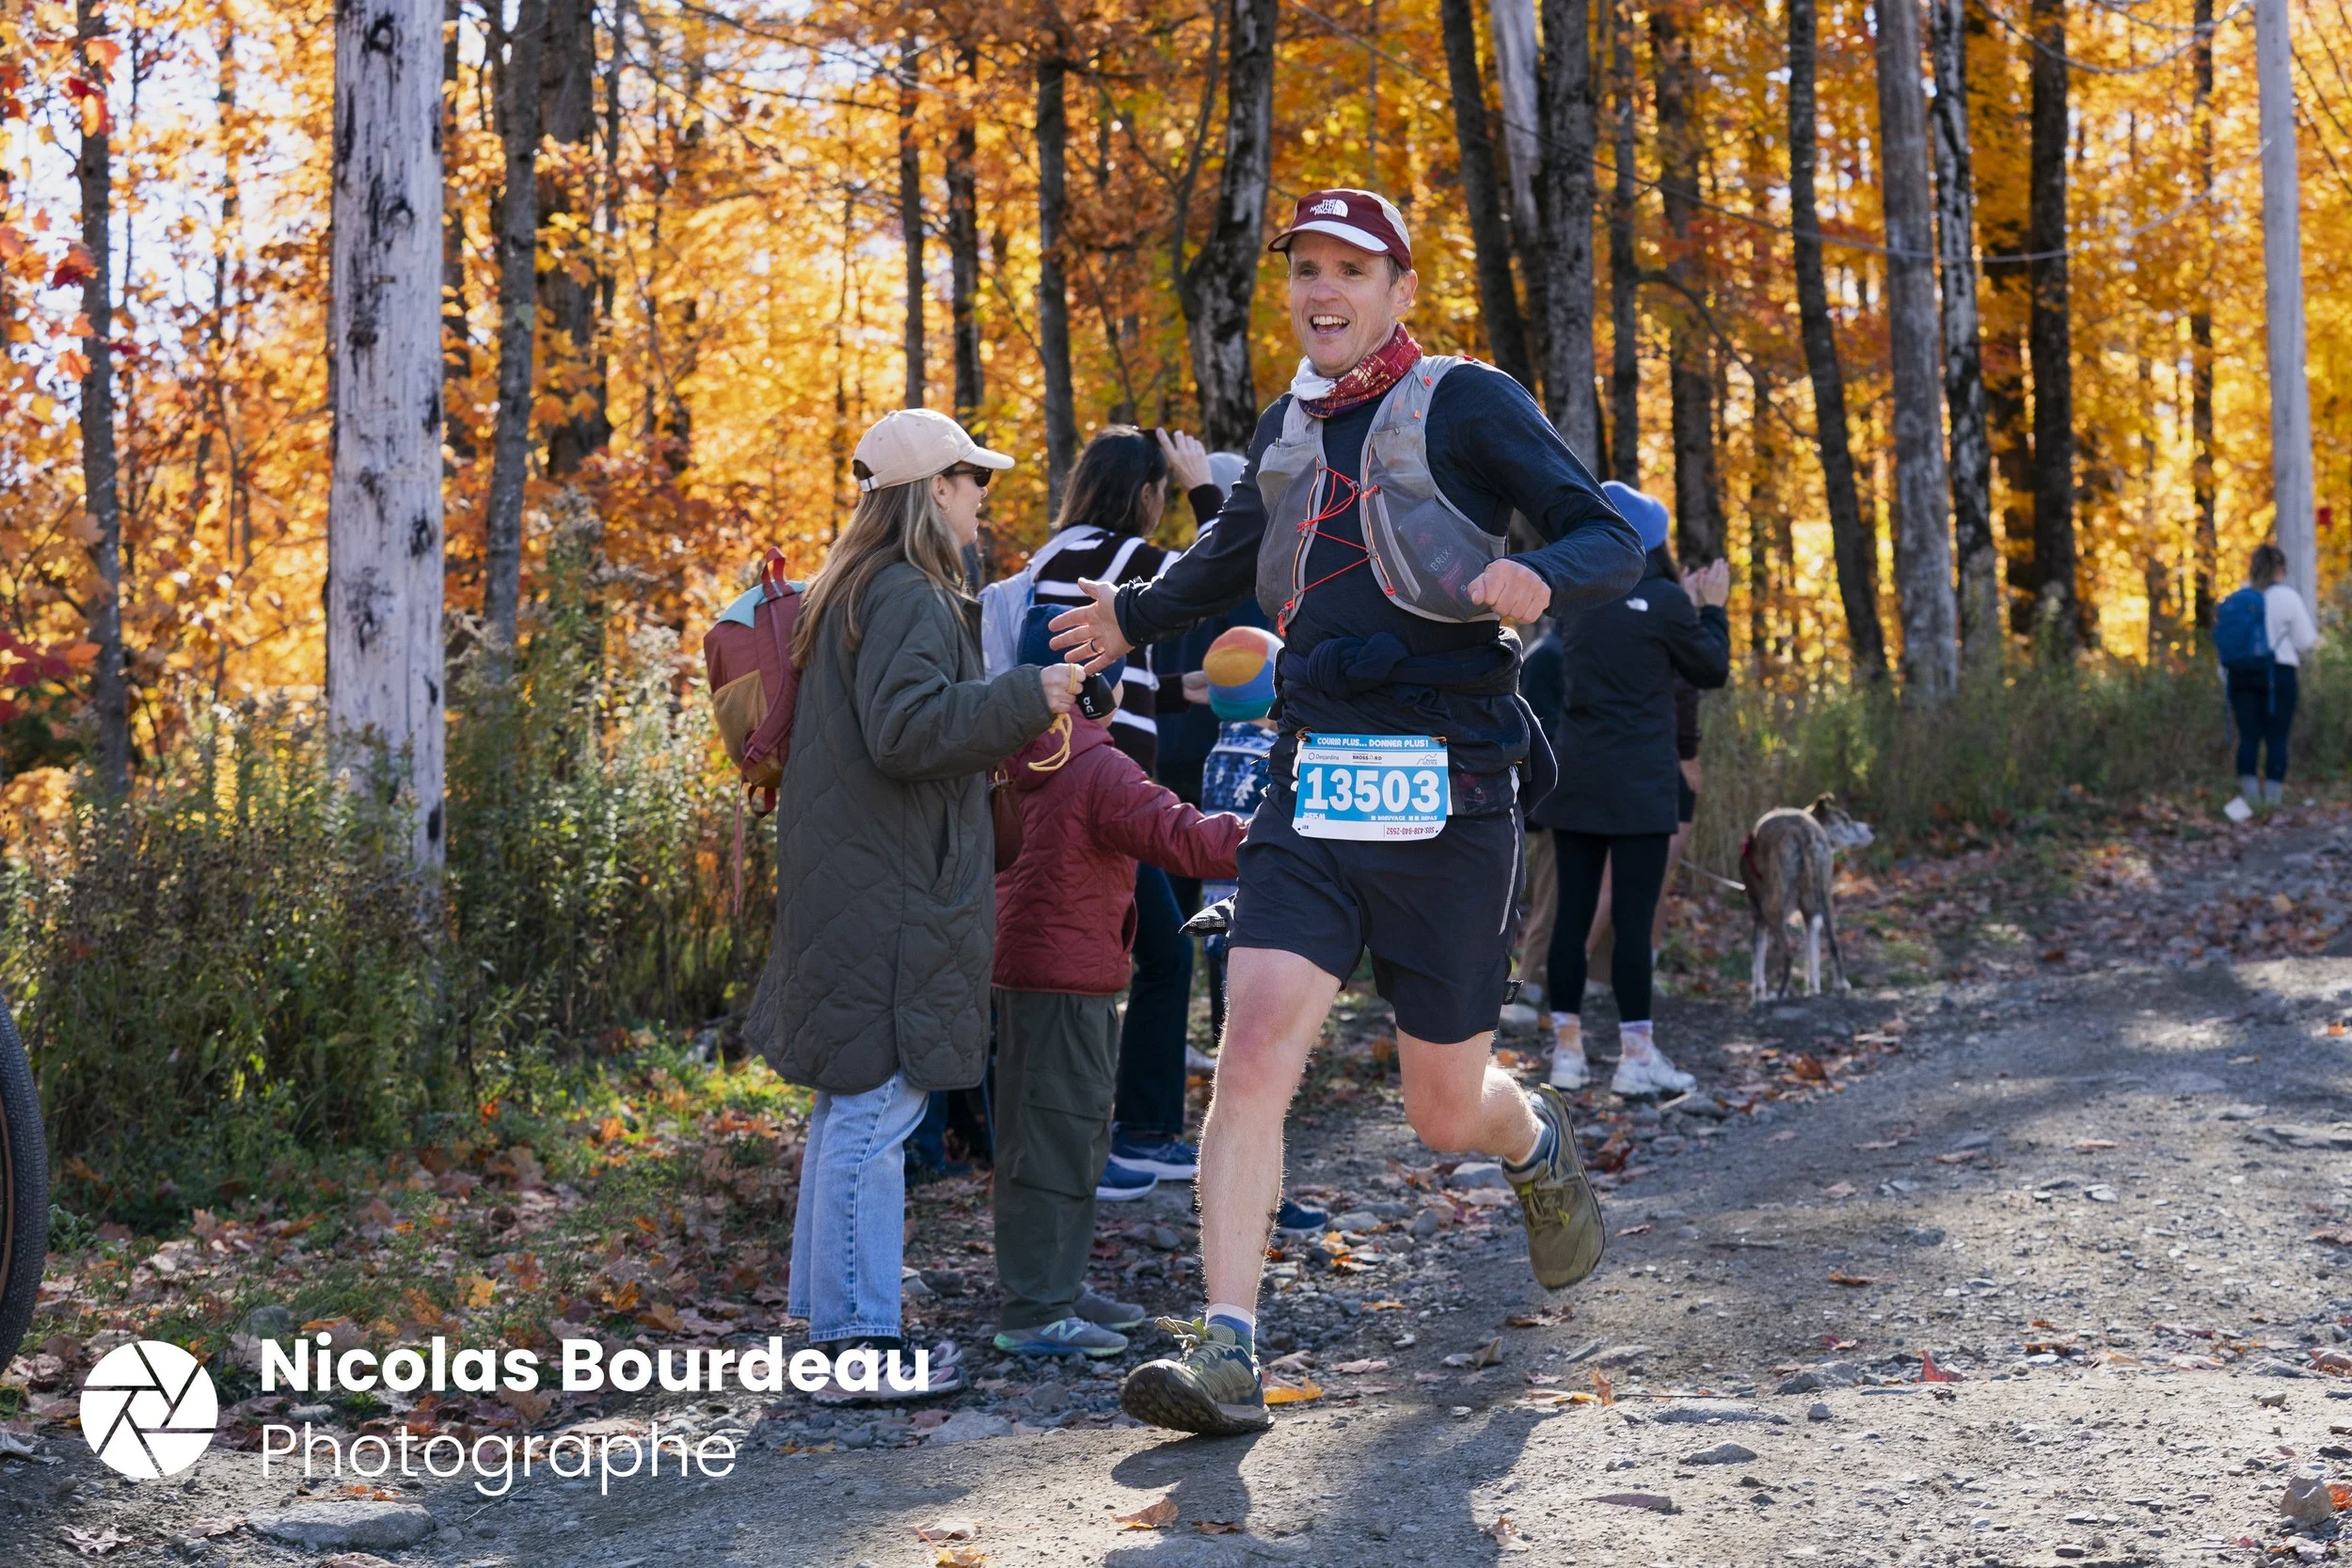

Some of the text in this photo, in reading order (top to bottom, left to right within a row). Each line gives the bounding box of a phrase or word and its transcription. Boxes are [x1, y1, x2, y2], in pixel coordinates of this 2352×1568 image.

[1430, 548, 1452, 572] BRIX
[1342, 738, 1368, 748] PLUS...
[1369, 738, 1403, 748] DONNER
[1404, 738, 1429, 748] PLUS!
[1303, 767, 1440, 814] 13503
